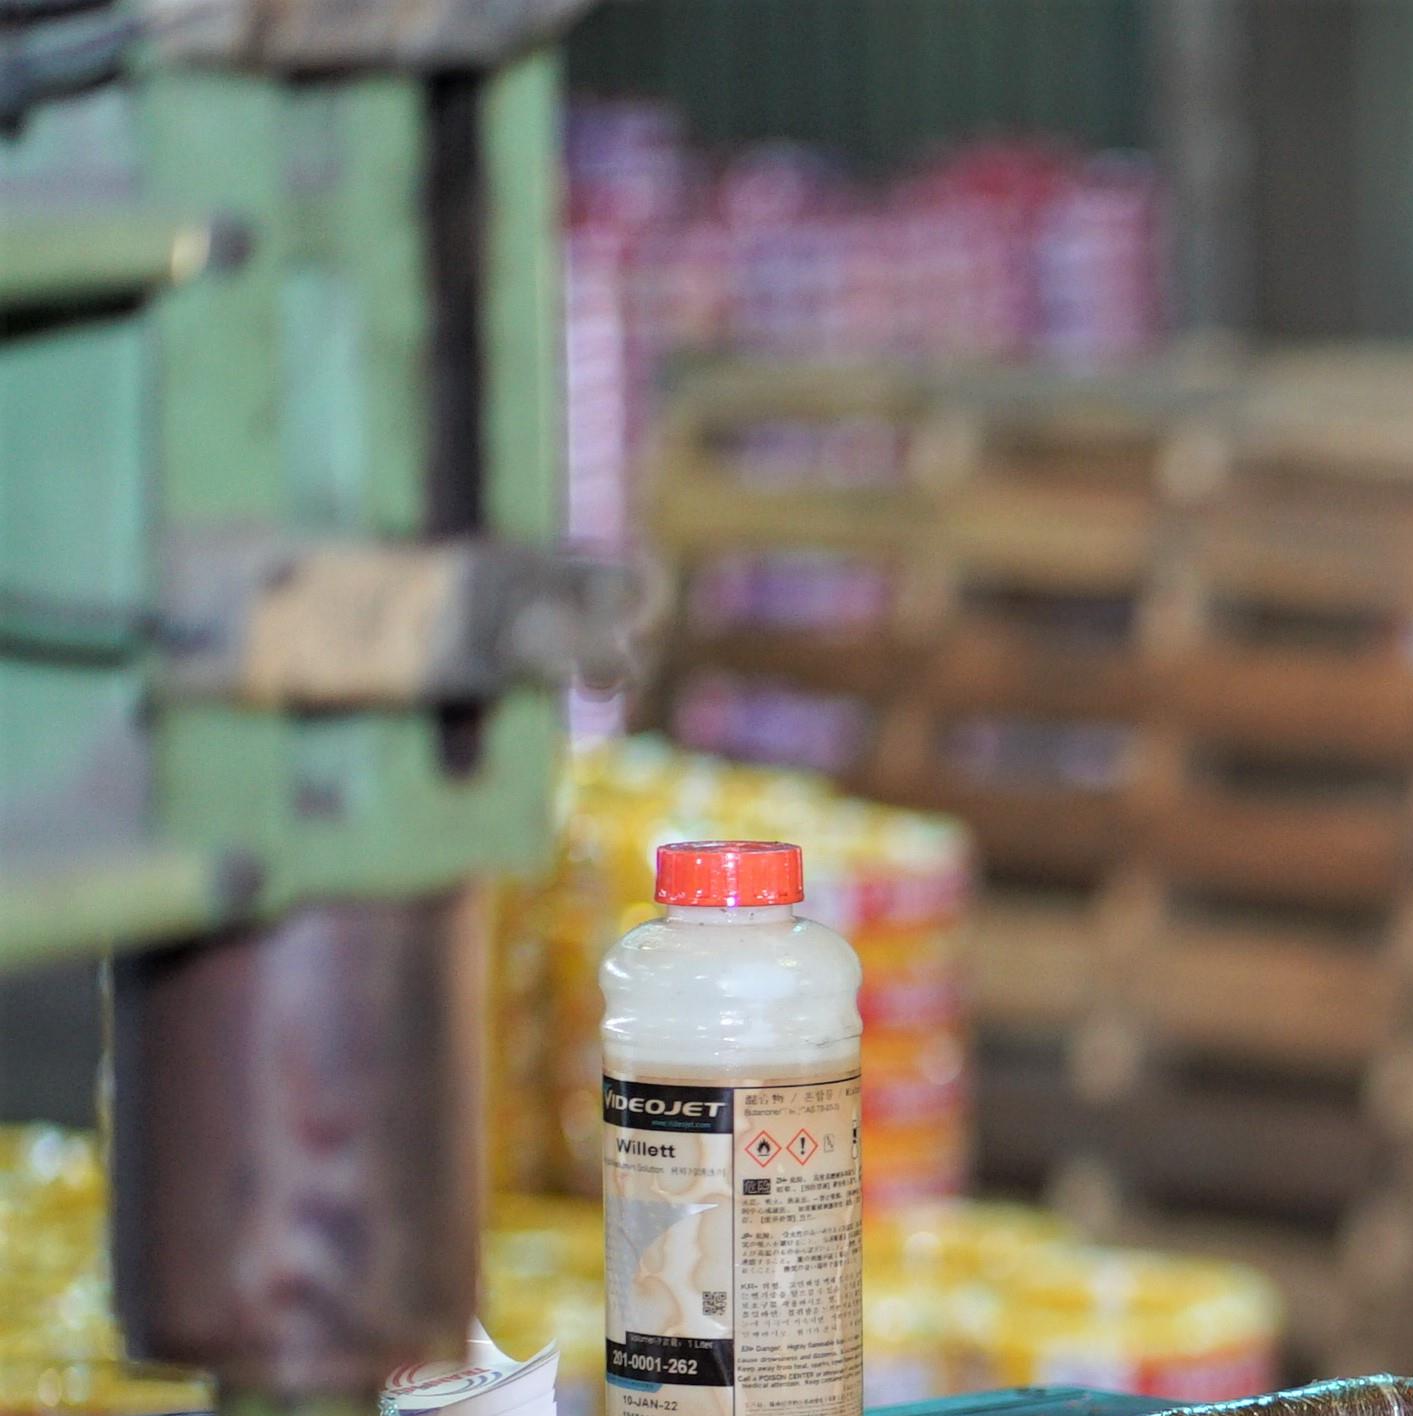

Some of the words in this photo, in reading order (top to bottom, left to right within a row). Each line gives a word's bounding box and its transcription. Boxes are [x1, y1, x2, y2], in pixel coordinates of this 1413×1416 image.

[604, 1089, 726, 1118] VIDEOJET
[616, 1137, 677, 1159] Willett
[613, 1349, 698, 1375] 201-0001-262
[623, 1394, 678, 1412] 10-JAN-22
